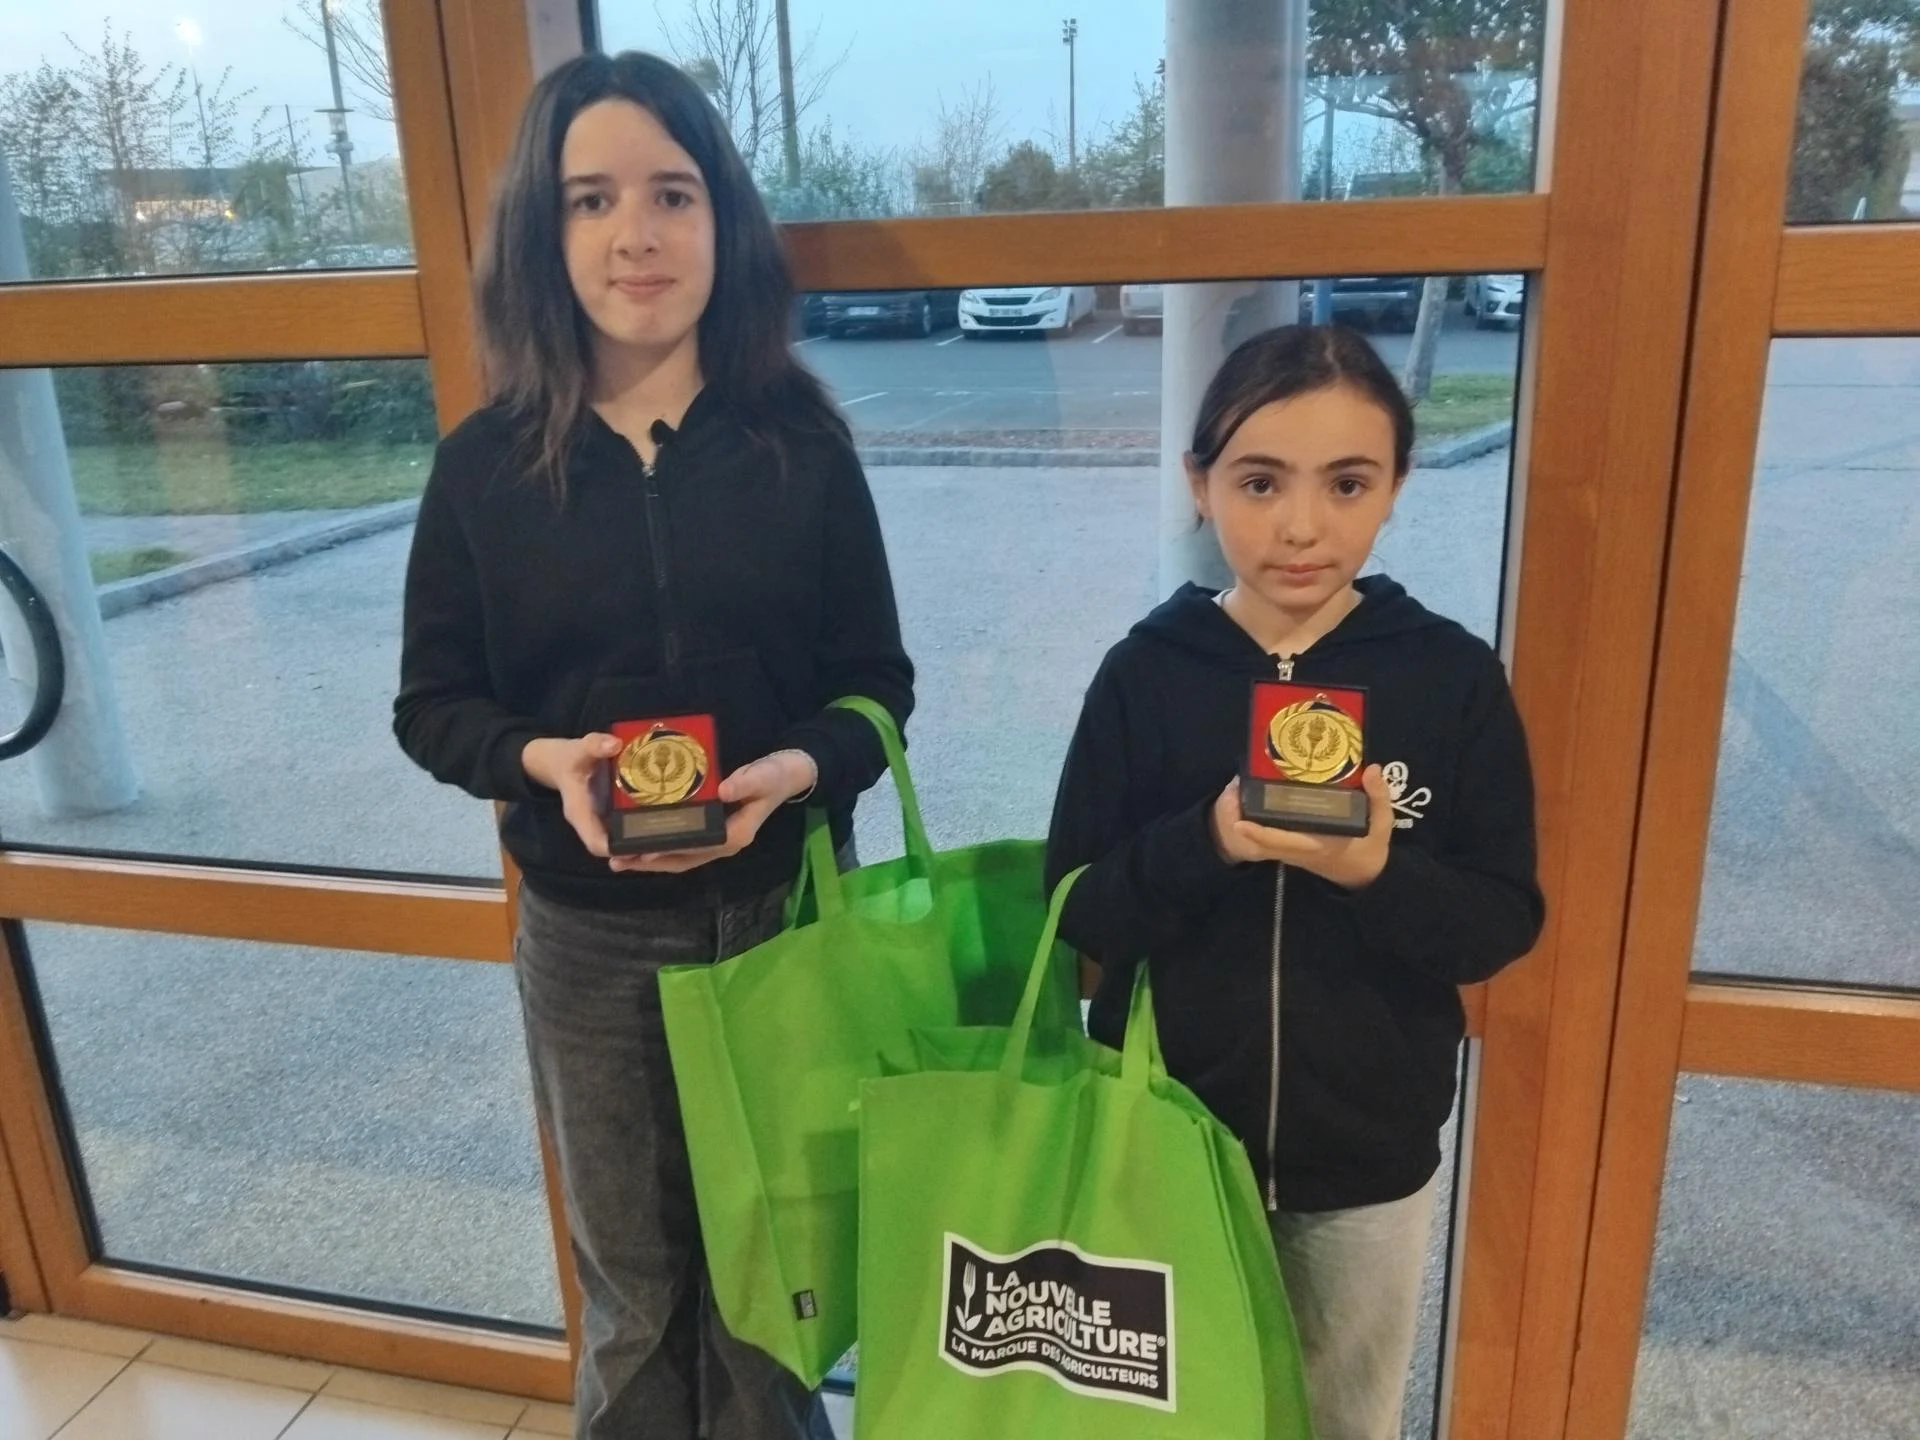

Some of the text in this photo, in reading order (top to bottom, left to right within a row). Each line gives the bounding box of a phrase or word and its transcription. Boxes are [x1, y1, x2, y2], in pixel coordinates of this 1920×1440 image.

[985, 1280, 1112, 1327] NOUVELLE
[986, 1270, 1021, 1292] LA
[951, 1336, 968, 1357] LA
[970, 1340, 1038, 1362] MARQUE
[1060, 1354, 1159, 1390] AGRICULTEURS
